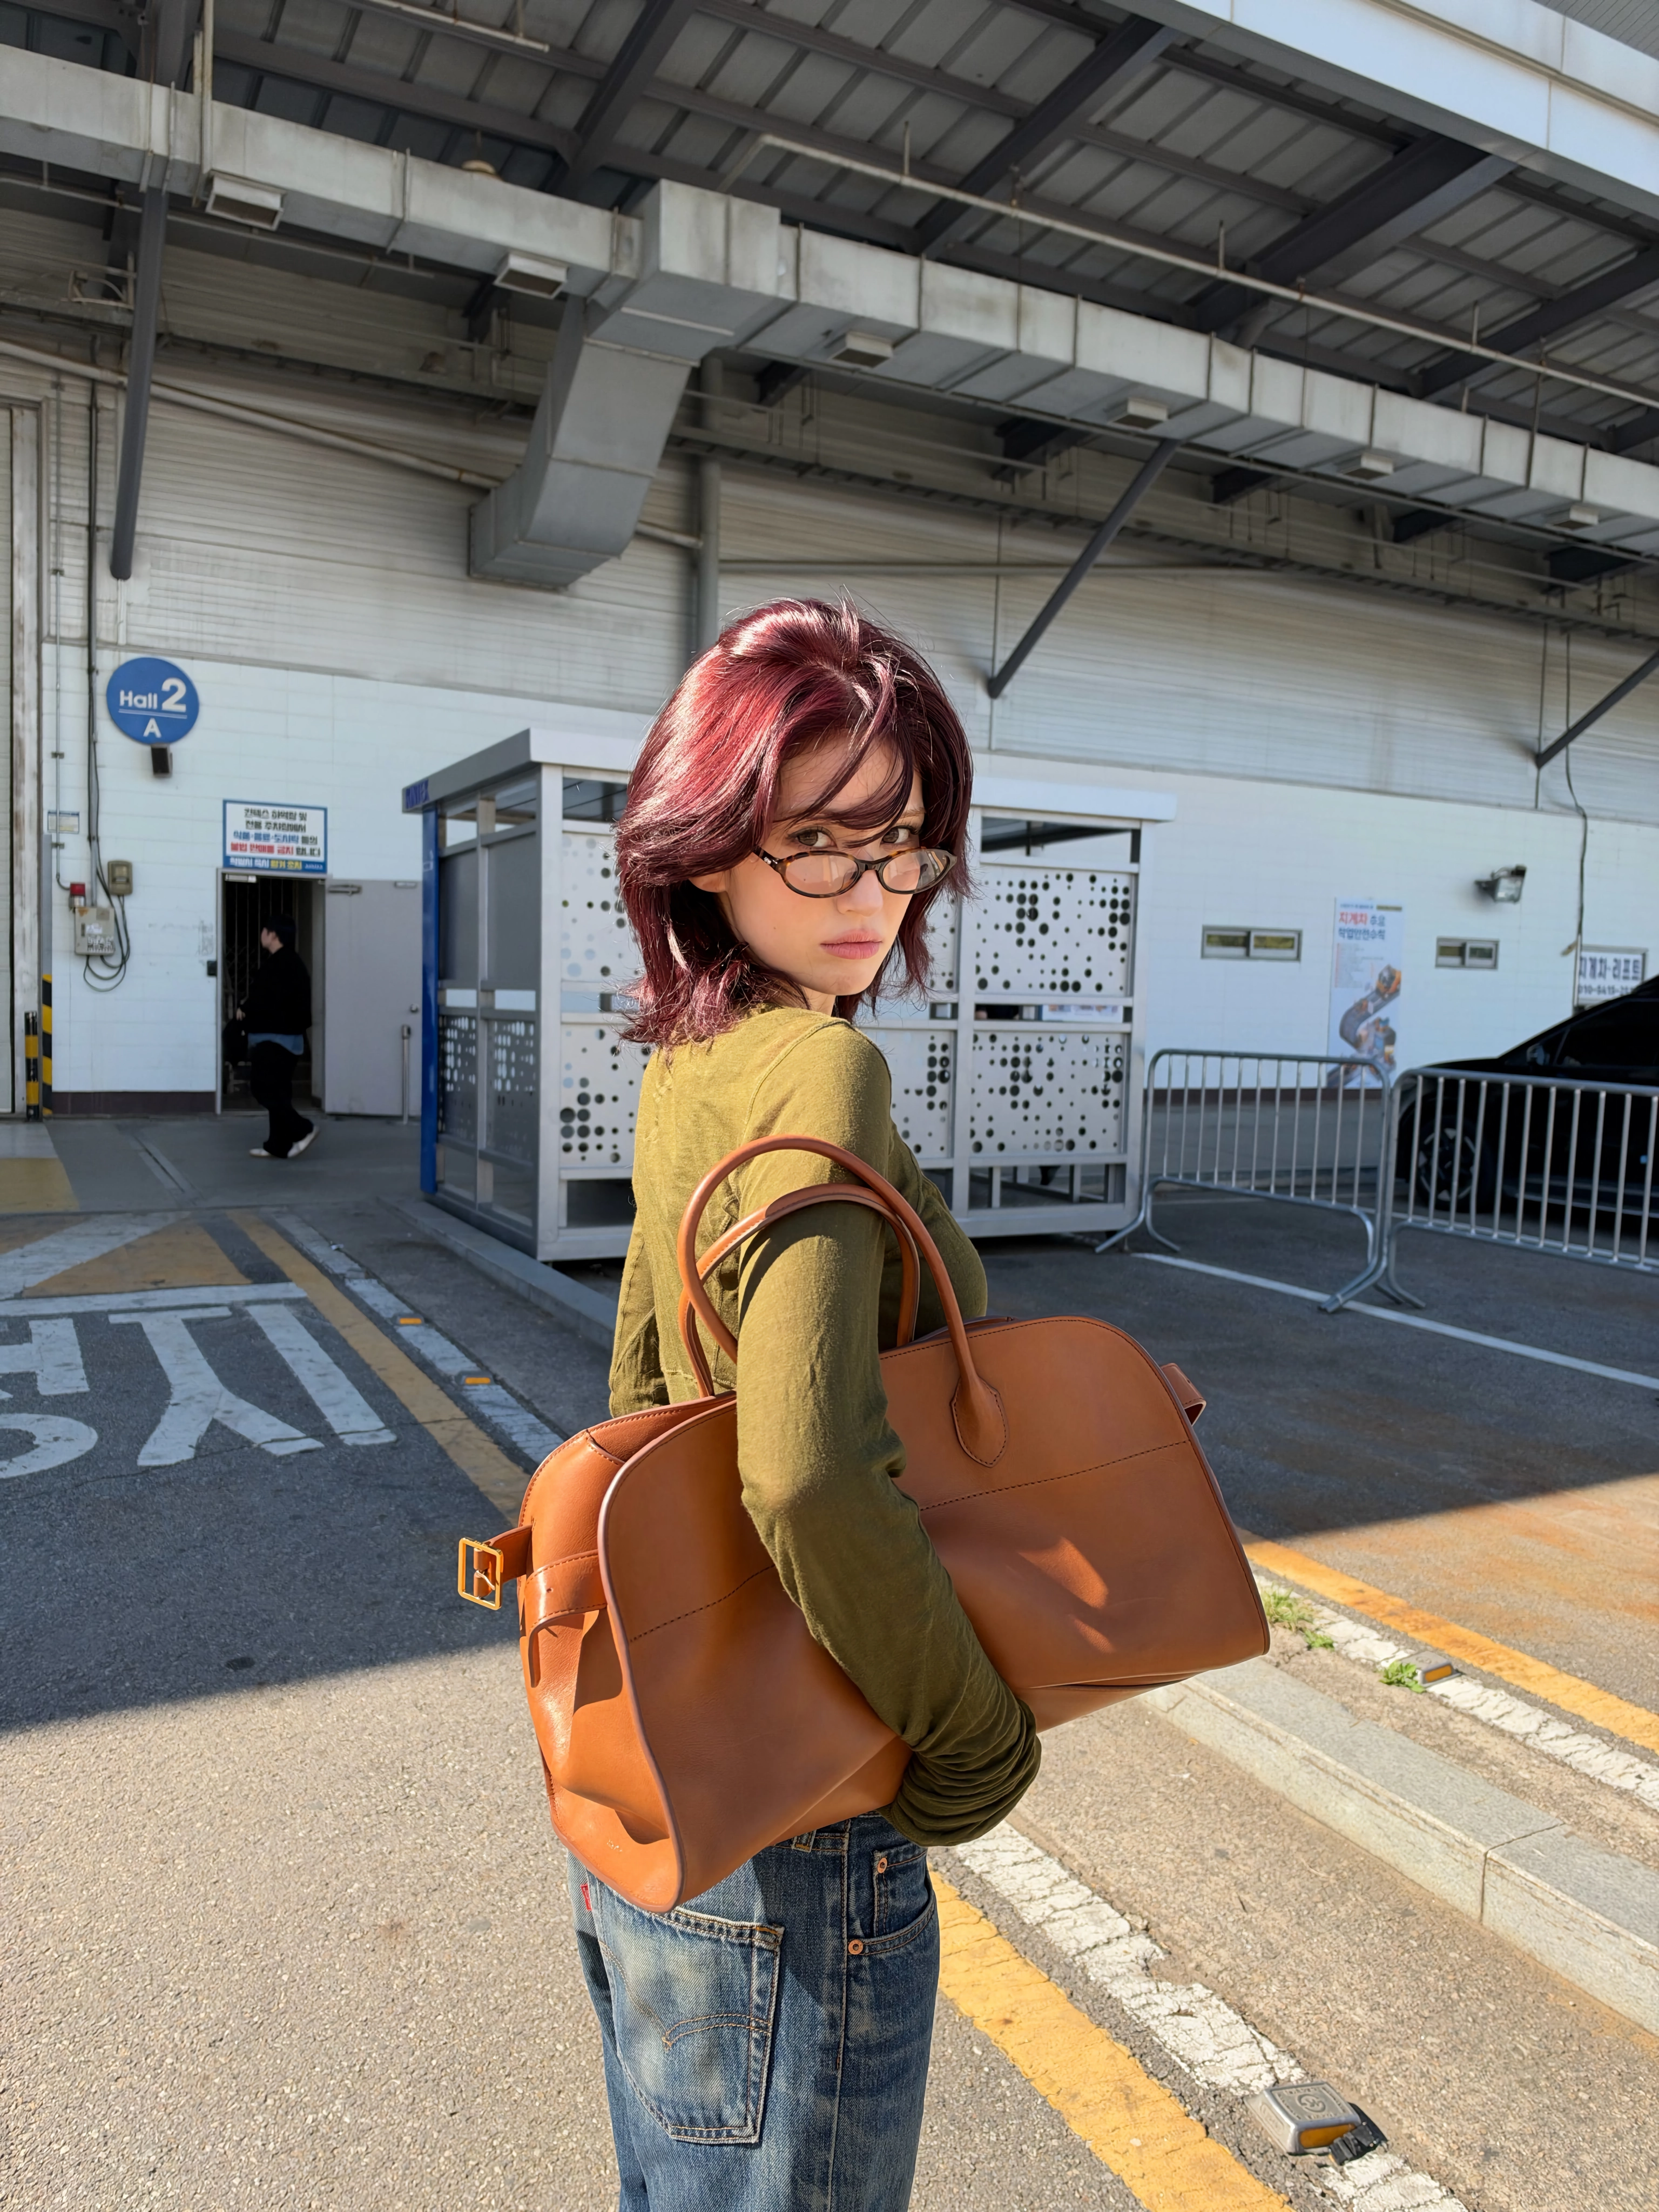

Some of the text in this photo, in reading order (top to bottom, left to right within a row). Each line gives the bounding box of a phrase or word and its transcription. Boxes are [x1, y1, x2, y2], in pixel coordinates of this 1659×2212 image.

[119, 677, 187, 713] Hall 2
[143, 718, 161, 738] A
